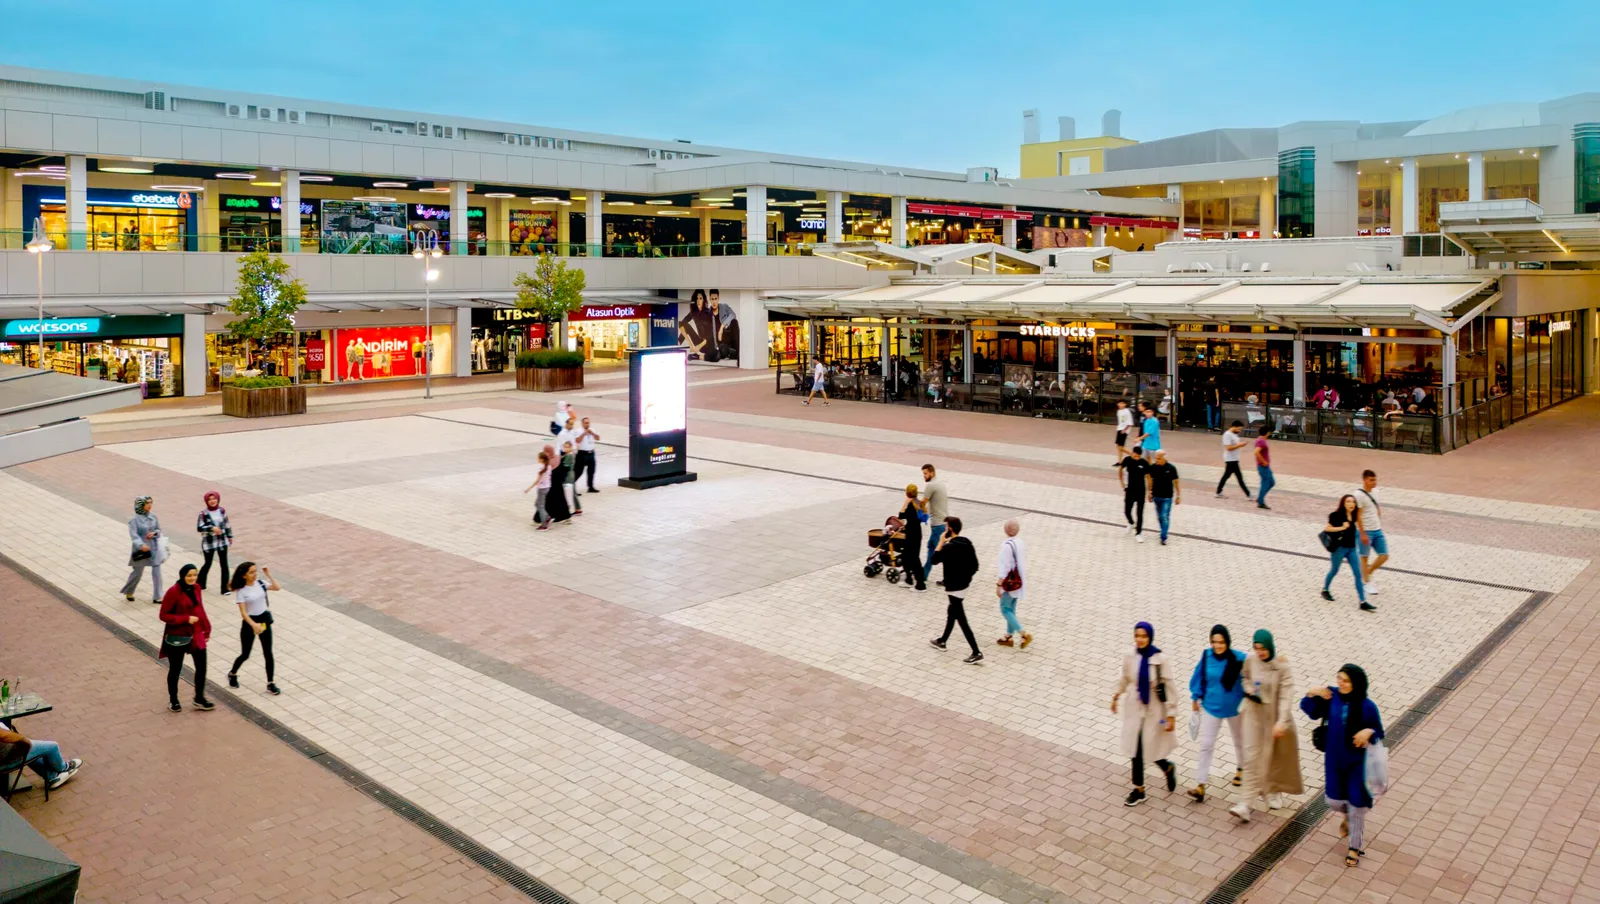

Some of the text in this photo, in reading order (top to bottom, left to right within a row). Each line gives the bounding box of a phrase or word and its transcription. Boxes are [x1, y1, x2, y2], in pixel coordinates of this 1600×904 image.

[132, 194, 177, 204] ebebek
[496, 309, 523, 321] LTB
[586, 307, 635, 318] Atasun Optik
[18, 322, 88, 333] watsons
[653, 317, 675, 328] mavi
[1019, 325, 1095, 337] STARBUCKS
[362, 338, 408, 352] NDİRİM
[308, 353, 324, 362] %50
